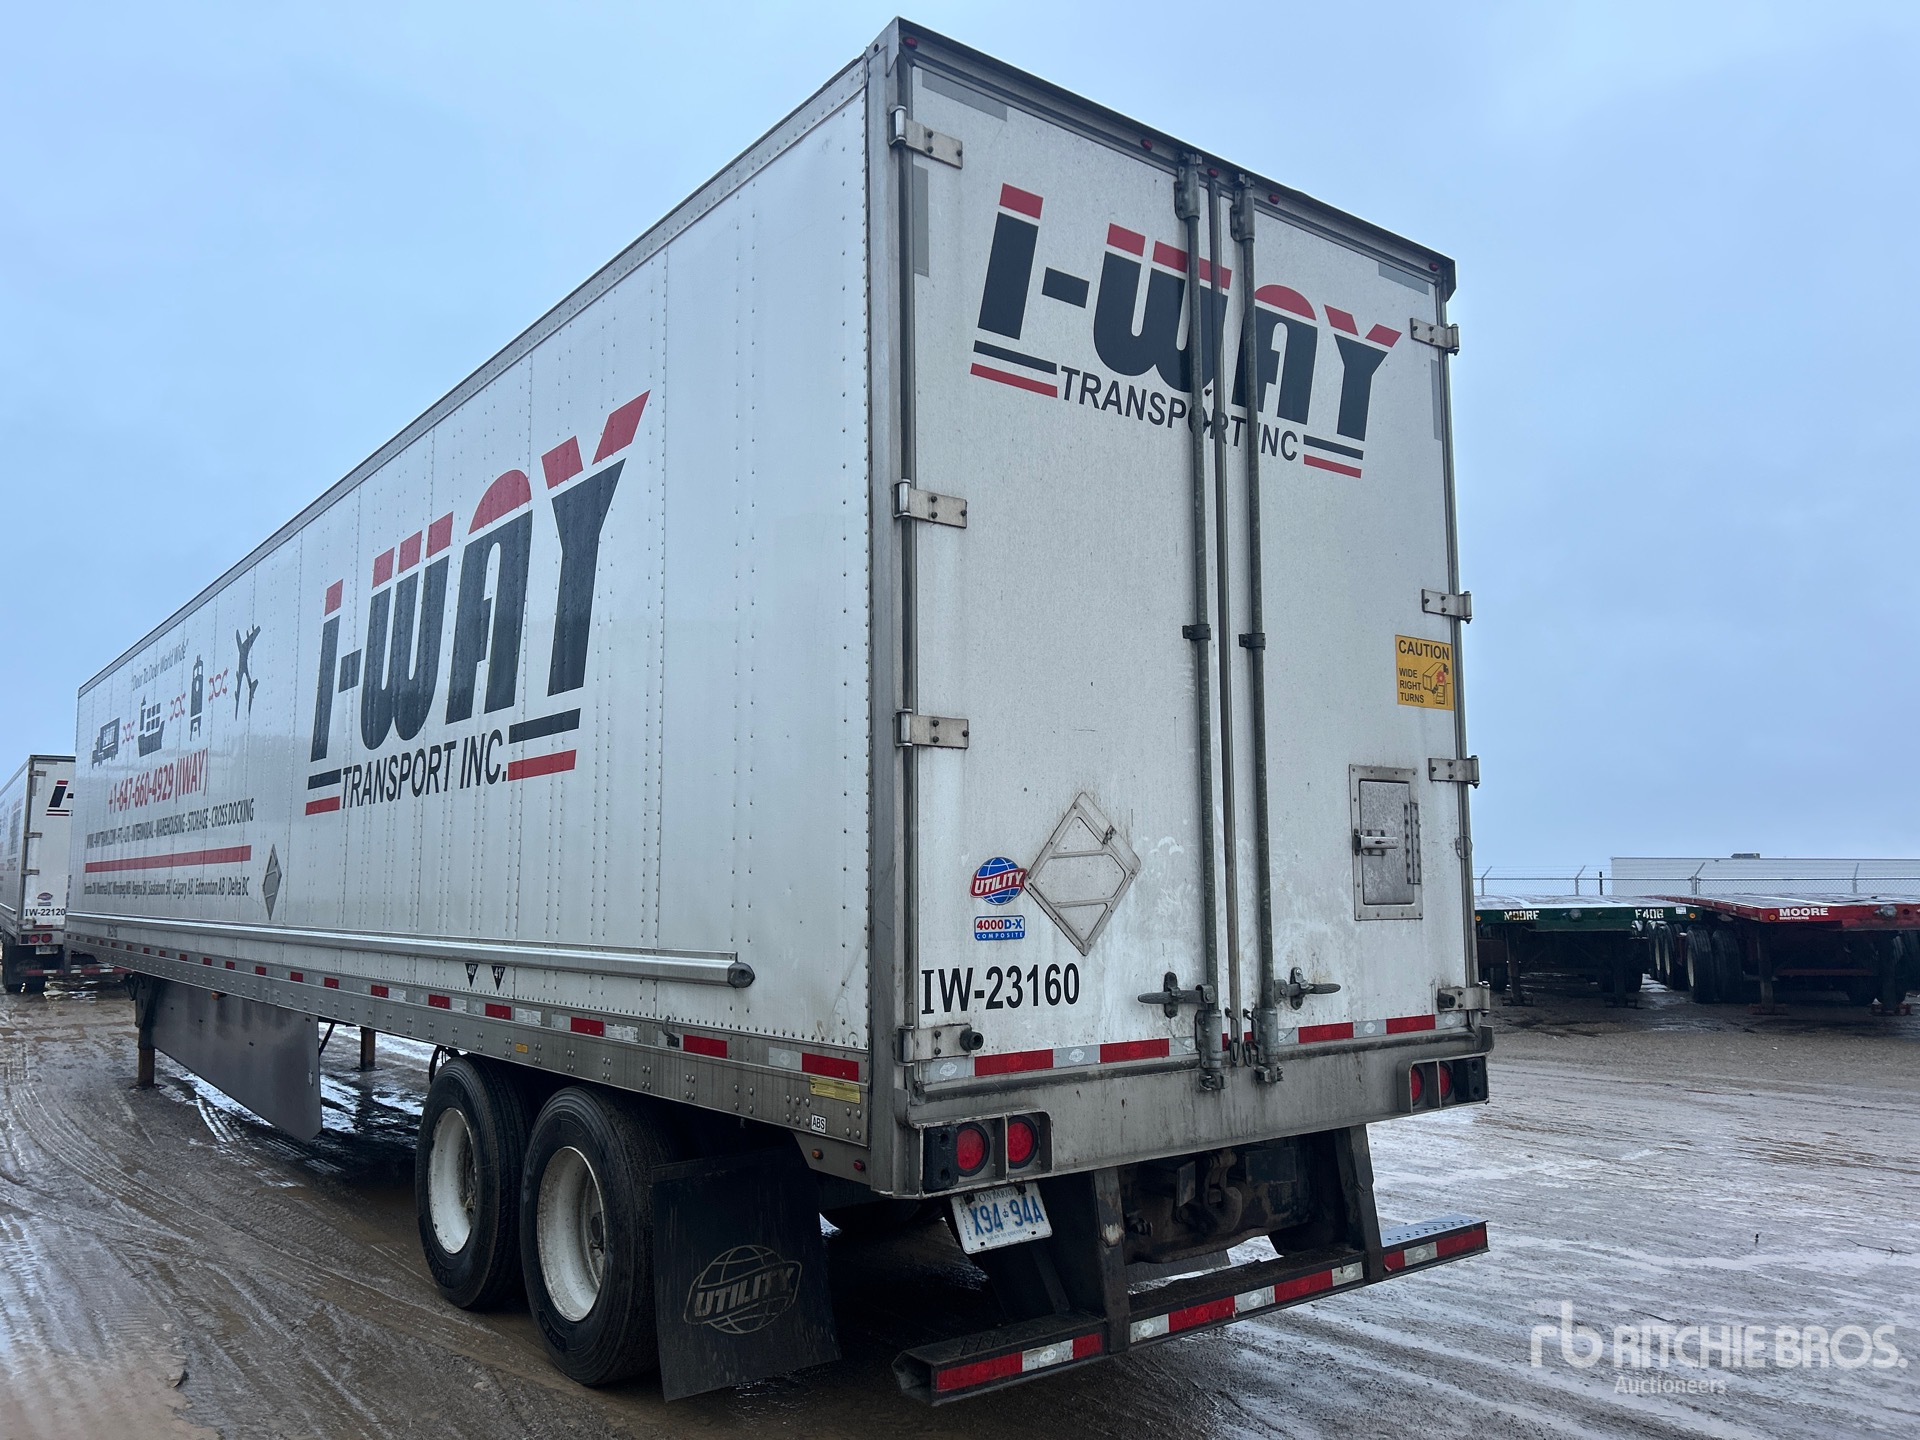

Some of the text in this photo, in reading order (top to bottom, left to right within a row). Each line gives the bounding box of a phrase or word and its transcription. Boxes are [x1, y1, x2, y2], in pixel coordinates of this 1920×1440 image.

[1256, 421, 1299, 461] NC
[1398, 640, 1450, 660] CAUTION
[1399, 667, 1418, 678] WIDE
[1399, 680, 1422, 691] RIGHT
[1400, 692, 1425, 703] TURNS
[175, 747, 208, 803] (IWAY)
[342, 729, 507, 808] TRANSPORT INC.
[187, 808, 209, 832] STORAGE
[211, 803, 228, 827] CROSS
[228, 798, 255, 825] DOCKING
[195, 877, 218, 895] Edmonton
[227, 876, 242, 896] Delta
[242, 876, 250, 896] BC
[974, 872, 1024, 894] UTILITY
[25, 908, 66, 917] IW-22120
[1503, 910, 1540, 921] MOORE
[1779, 907, 1829, 916] MOORE
[976, 919, 1023, 930] 4000D-X
[921, 963, 1080, 1015] IW-23160
[813, 1116, 825, 1130] ABS
[978, 1189, 1016, 1203] ONTARIO
[970, 1195, 1044, 1236] X94 94A
[694, 1267, 795, 1317] UTILITY
